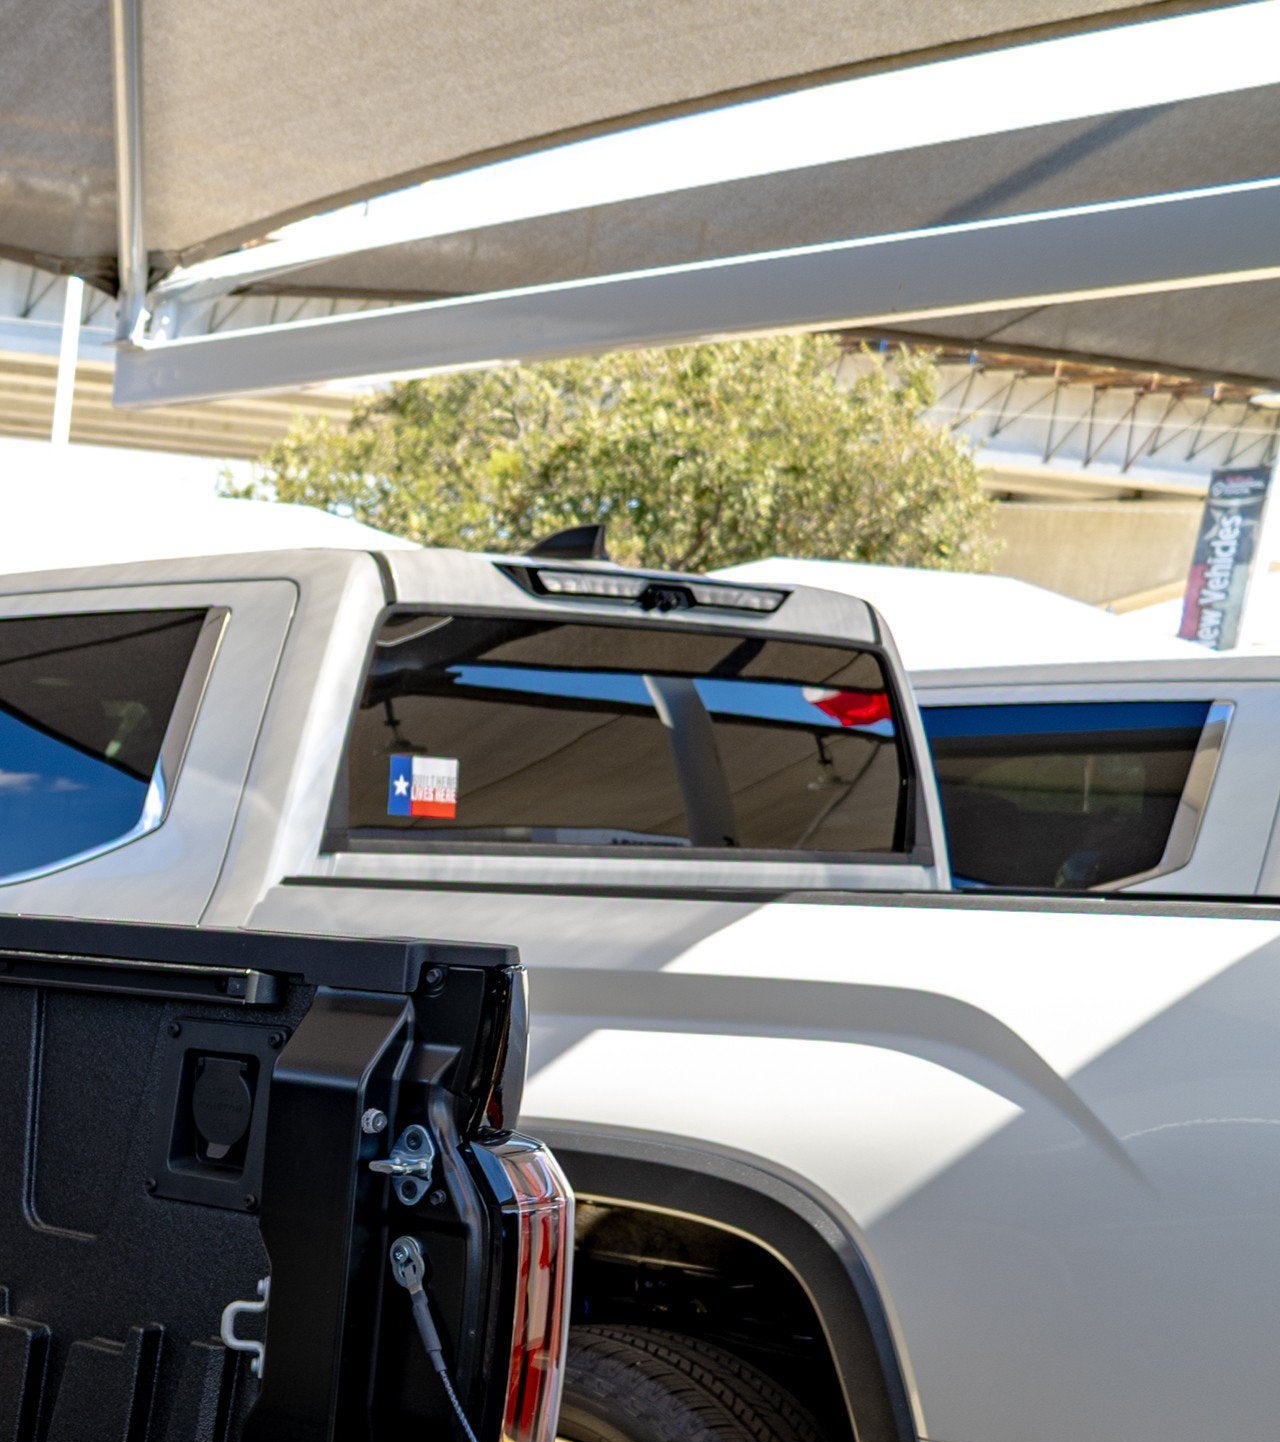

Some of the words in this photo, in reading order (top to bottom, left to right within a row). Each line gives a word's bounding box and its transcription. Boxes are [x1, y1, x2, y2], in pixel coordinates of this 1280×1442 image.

[1198, 514, 1243, 605] Vehicles
[411, 786, 433, 801] LIVES
[435, 787, 457, 803] HERE
